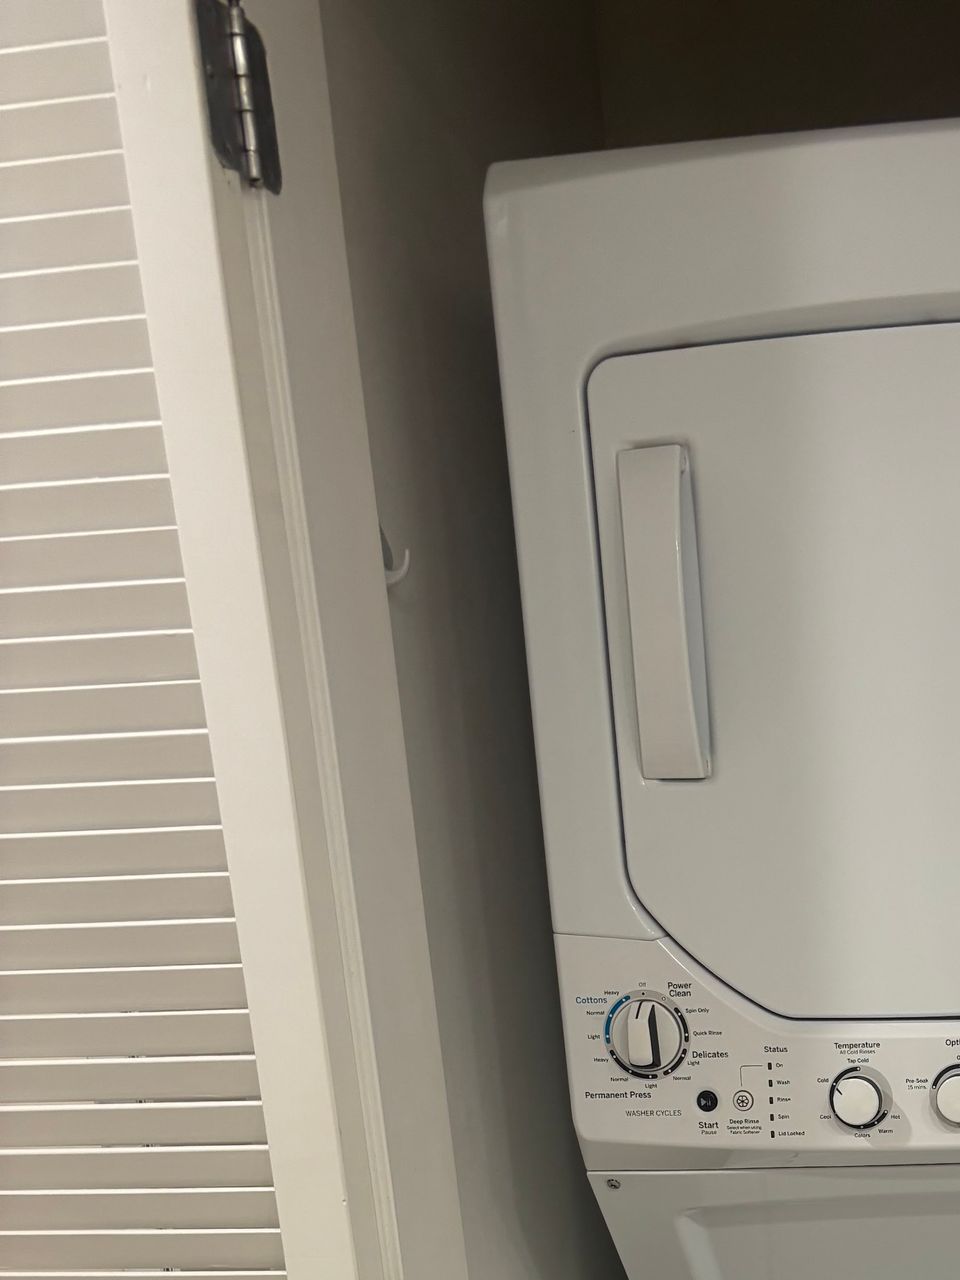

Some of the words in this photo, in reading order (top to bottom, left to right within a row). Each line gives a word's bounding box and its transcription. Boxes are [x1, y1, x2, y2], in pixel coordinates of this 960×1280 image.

[668, 982, 692, 990] Power
[576, 996, 608, 1004] Cottons
[834, 1042, 881, 1051] Temperature
[692, 1051, 728, 1059] Delicates
[585, 1091, 628, 1099] Permanent
[630, 1091, 652, 1099] Press
